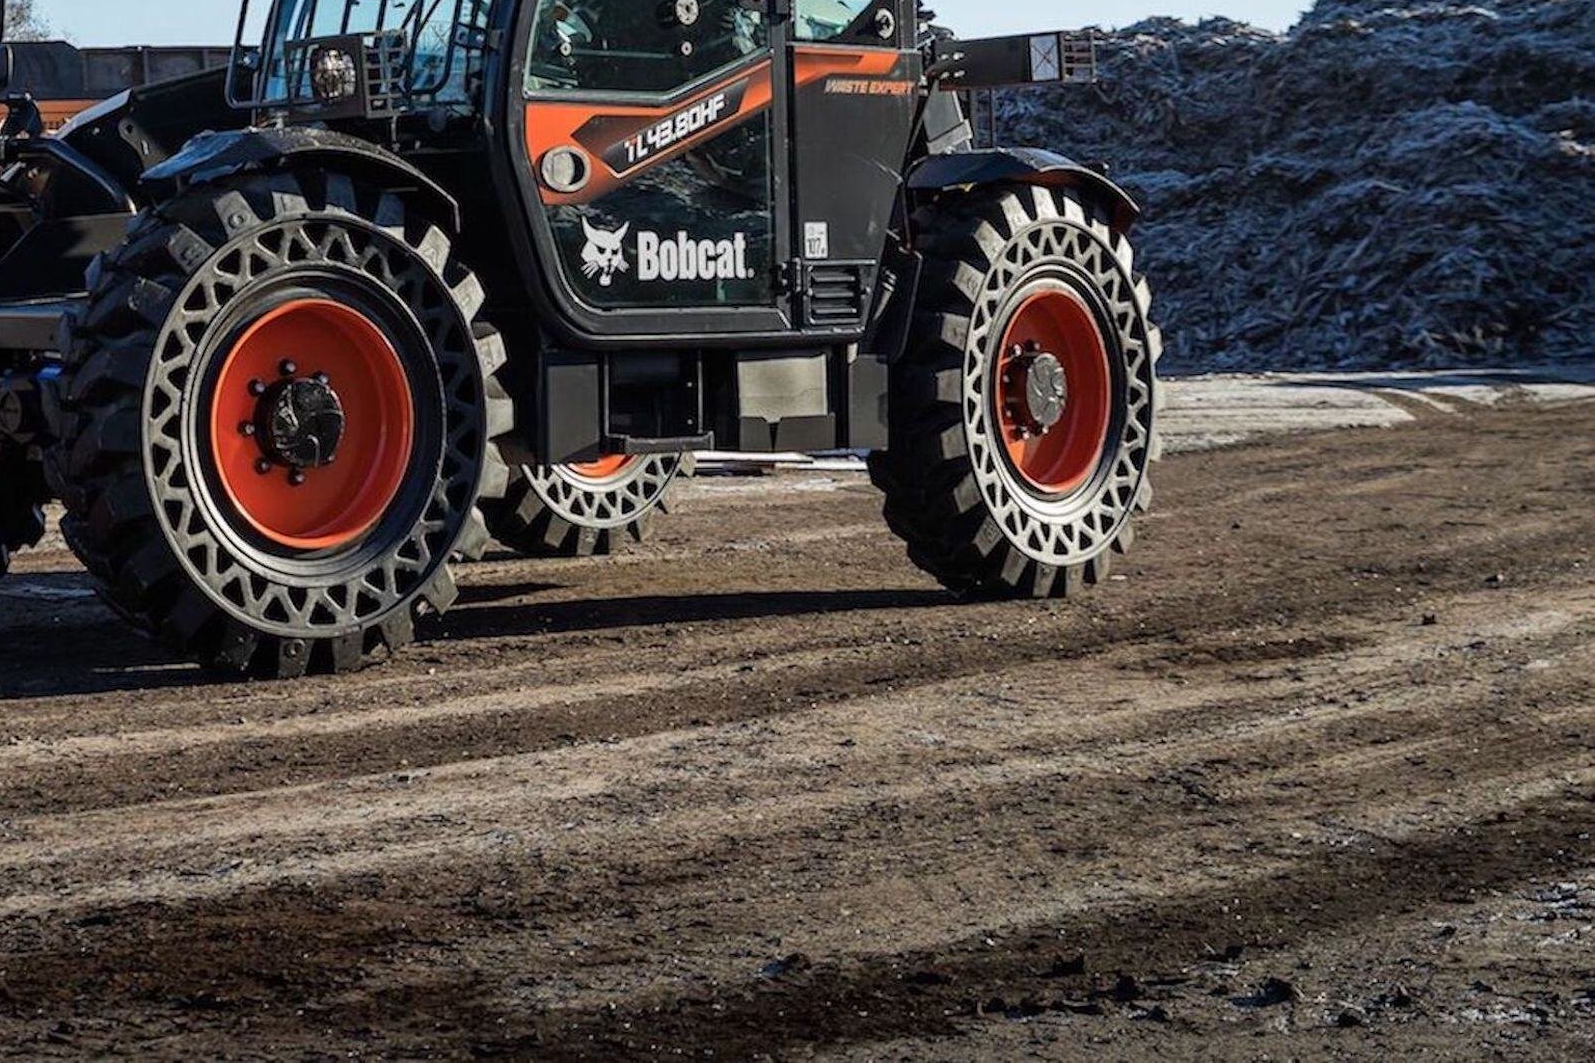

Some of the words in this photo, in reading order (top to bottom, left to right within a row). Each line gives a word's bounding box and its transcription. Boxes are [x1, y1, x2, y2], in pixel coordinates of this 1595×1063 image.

[824, 79, 868, 94] WASTE
[868, 80, 916, 96] EXPERT
[623, 92, 726, 163] TL43.80HF
[637, 230, 747, 281] Bobcat
